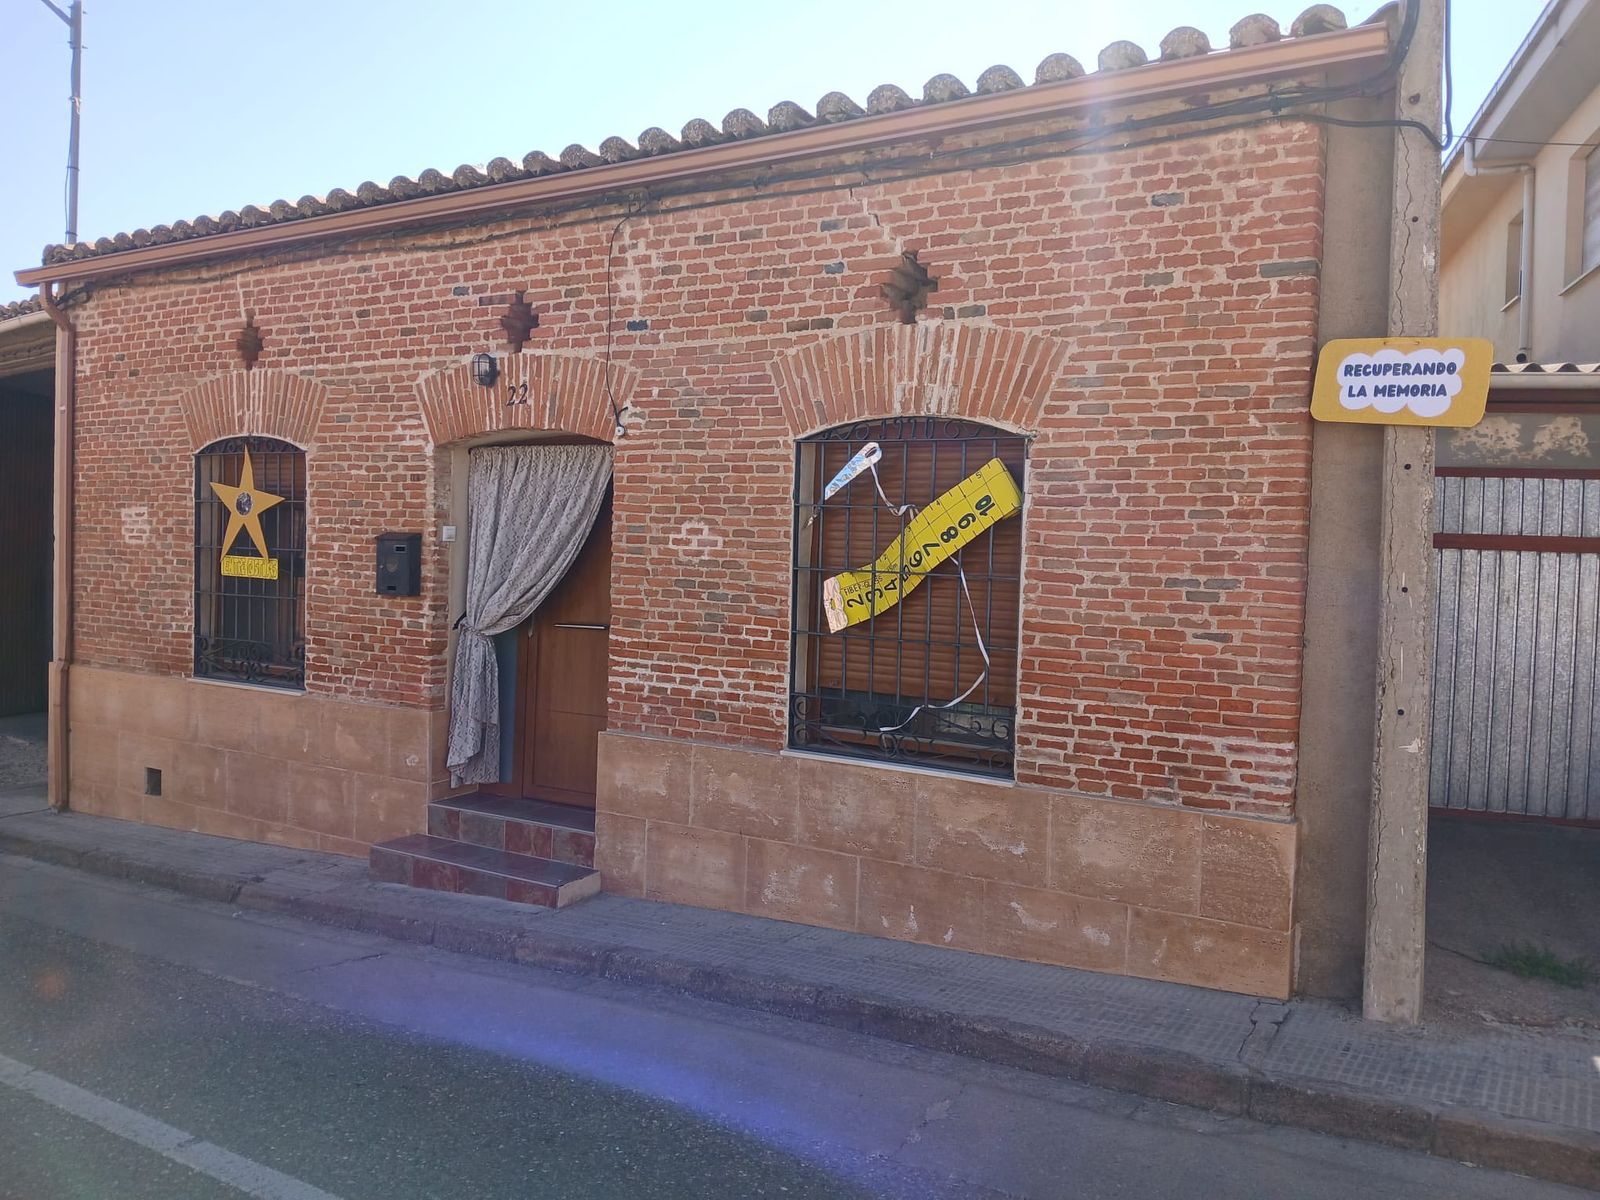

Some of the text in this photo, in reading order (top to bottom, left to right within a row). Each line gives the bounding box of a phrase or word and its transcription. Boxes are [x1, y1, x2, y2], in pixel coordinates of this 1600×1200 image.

[1343, 361, 1457, 377] RECUPERANDO
[506, 383, 528, 407] 22
[1348, 383, 1447, 398] LA MEMORIA
[847, 593, 864, 608] 2
[884, 577, 898, 591] 4
[909, 550, 923, 568] 6
[922, 542, 940, 557] 7
[940, 526, 959, 543] 8
[957, 512, 976, 530] 9
[975, 494, 996, 517] 10
